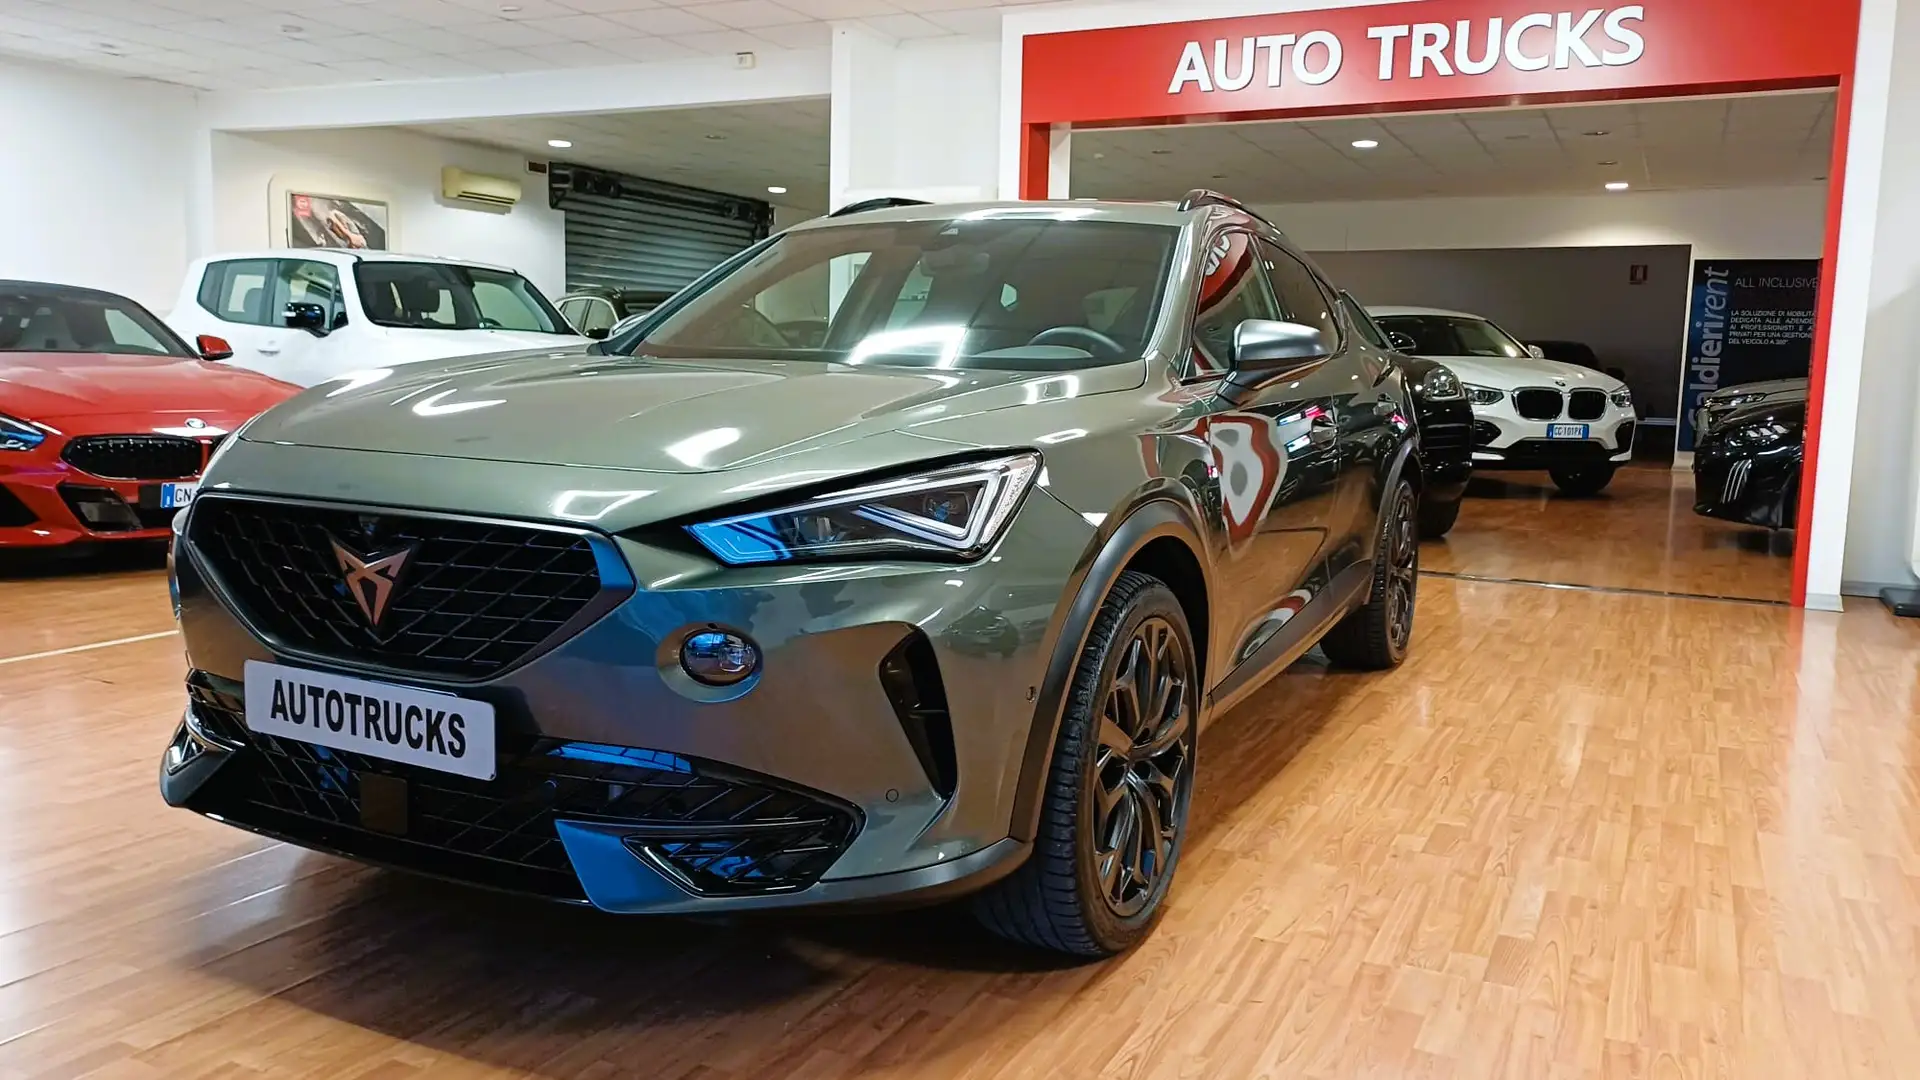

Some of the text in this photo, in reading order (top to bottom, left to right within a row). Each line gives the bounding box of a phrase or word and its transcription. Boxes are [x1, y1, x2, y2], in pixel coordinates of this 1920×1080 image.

[1167, 5, 1645, 94] AUTO TRUCKS
[1735, 277, 1818, 288] ALL INCLUSIVE
[270, 679, 467, 759] AUTOTRUCKS
